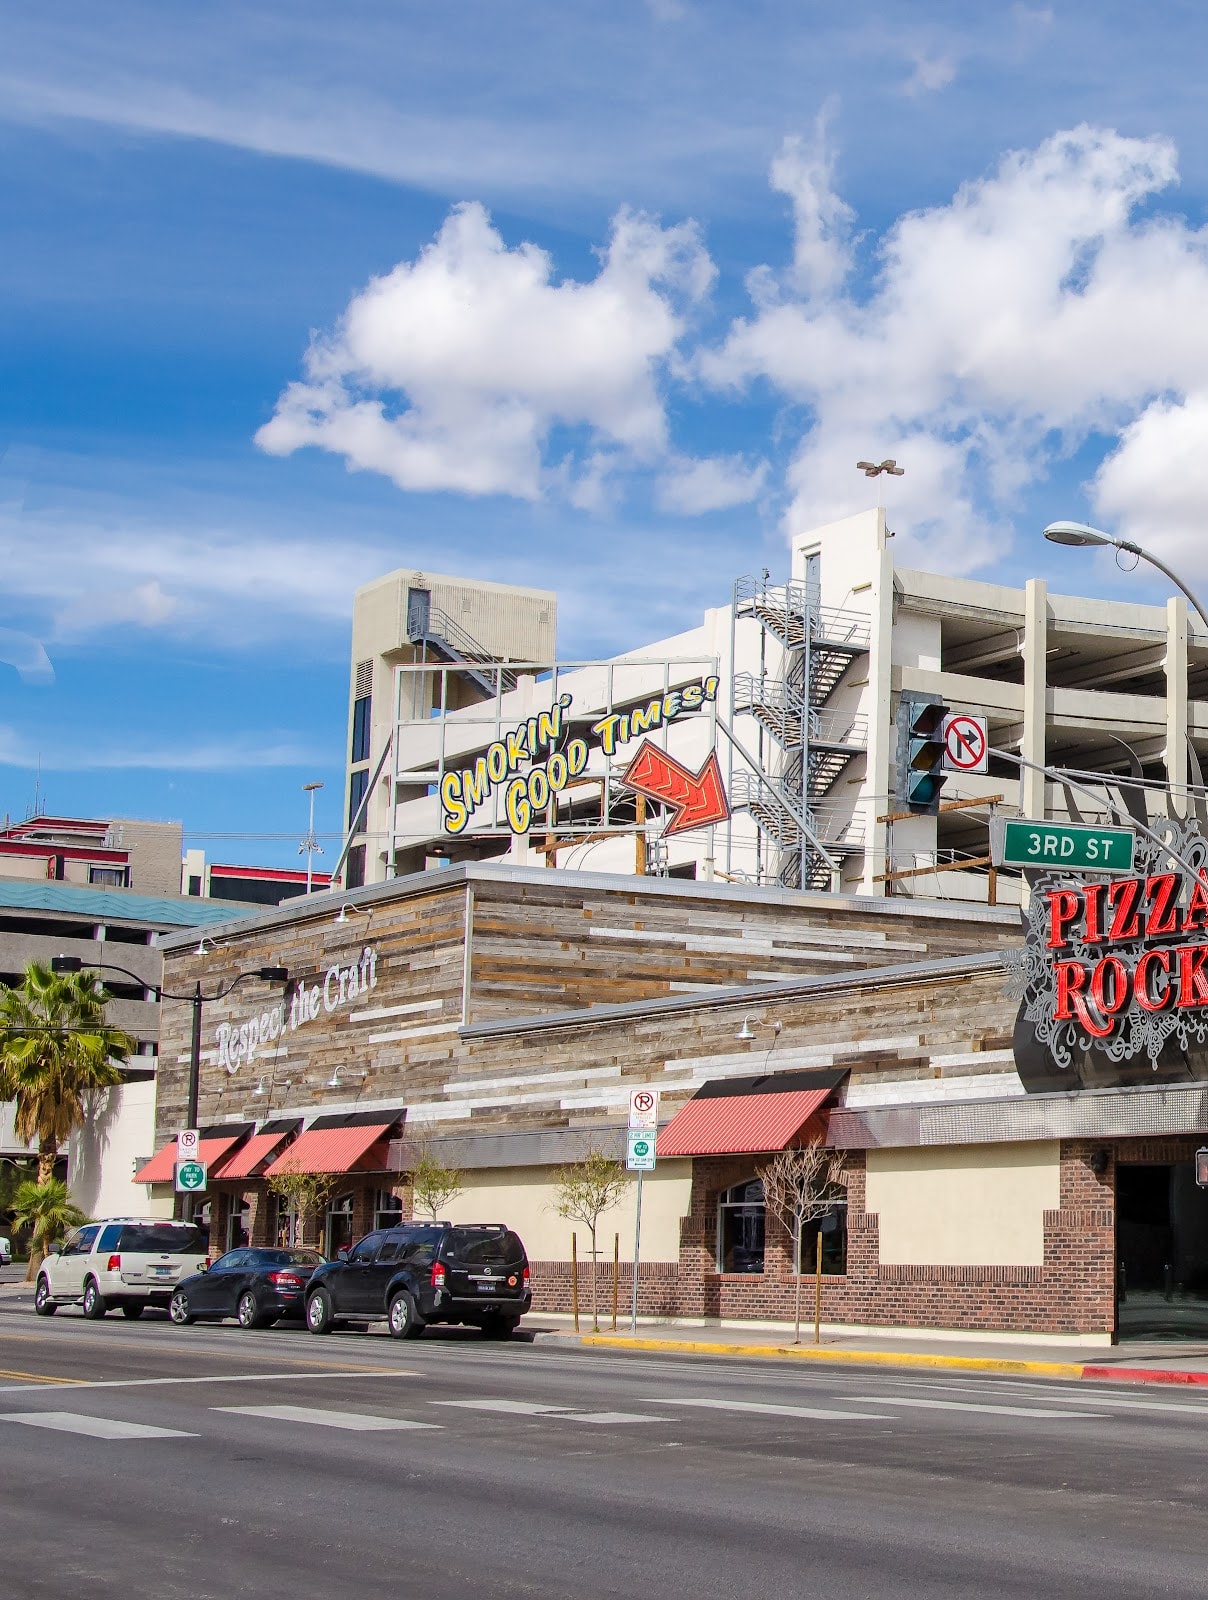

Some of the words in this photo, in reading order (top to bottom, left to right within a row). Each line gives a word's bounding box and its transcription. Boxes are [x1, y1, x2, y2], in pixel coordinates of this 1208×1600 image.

[441, 693, 572, 834] SMOKIN'
[506, 738, 589, 834] GOOD
[591, 676, 720, 756] TIMES!
[1027, 833, 1075, 857] 3RD
[1085, 838, 1114, 860] ST
[215, 1003, 287, 1074] Respect
[291, 980, 320, 1031] the
[324, 947, 378, 1012] Craft
